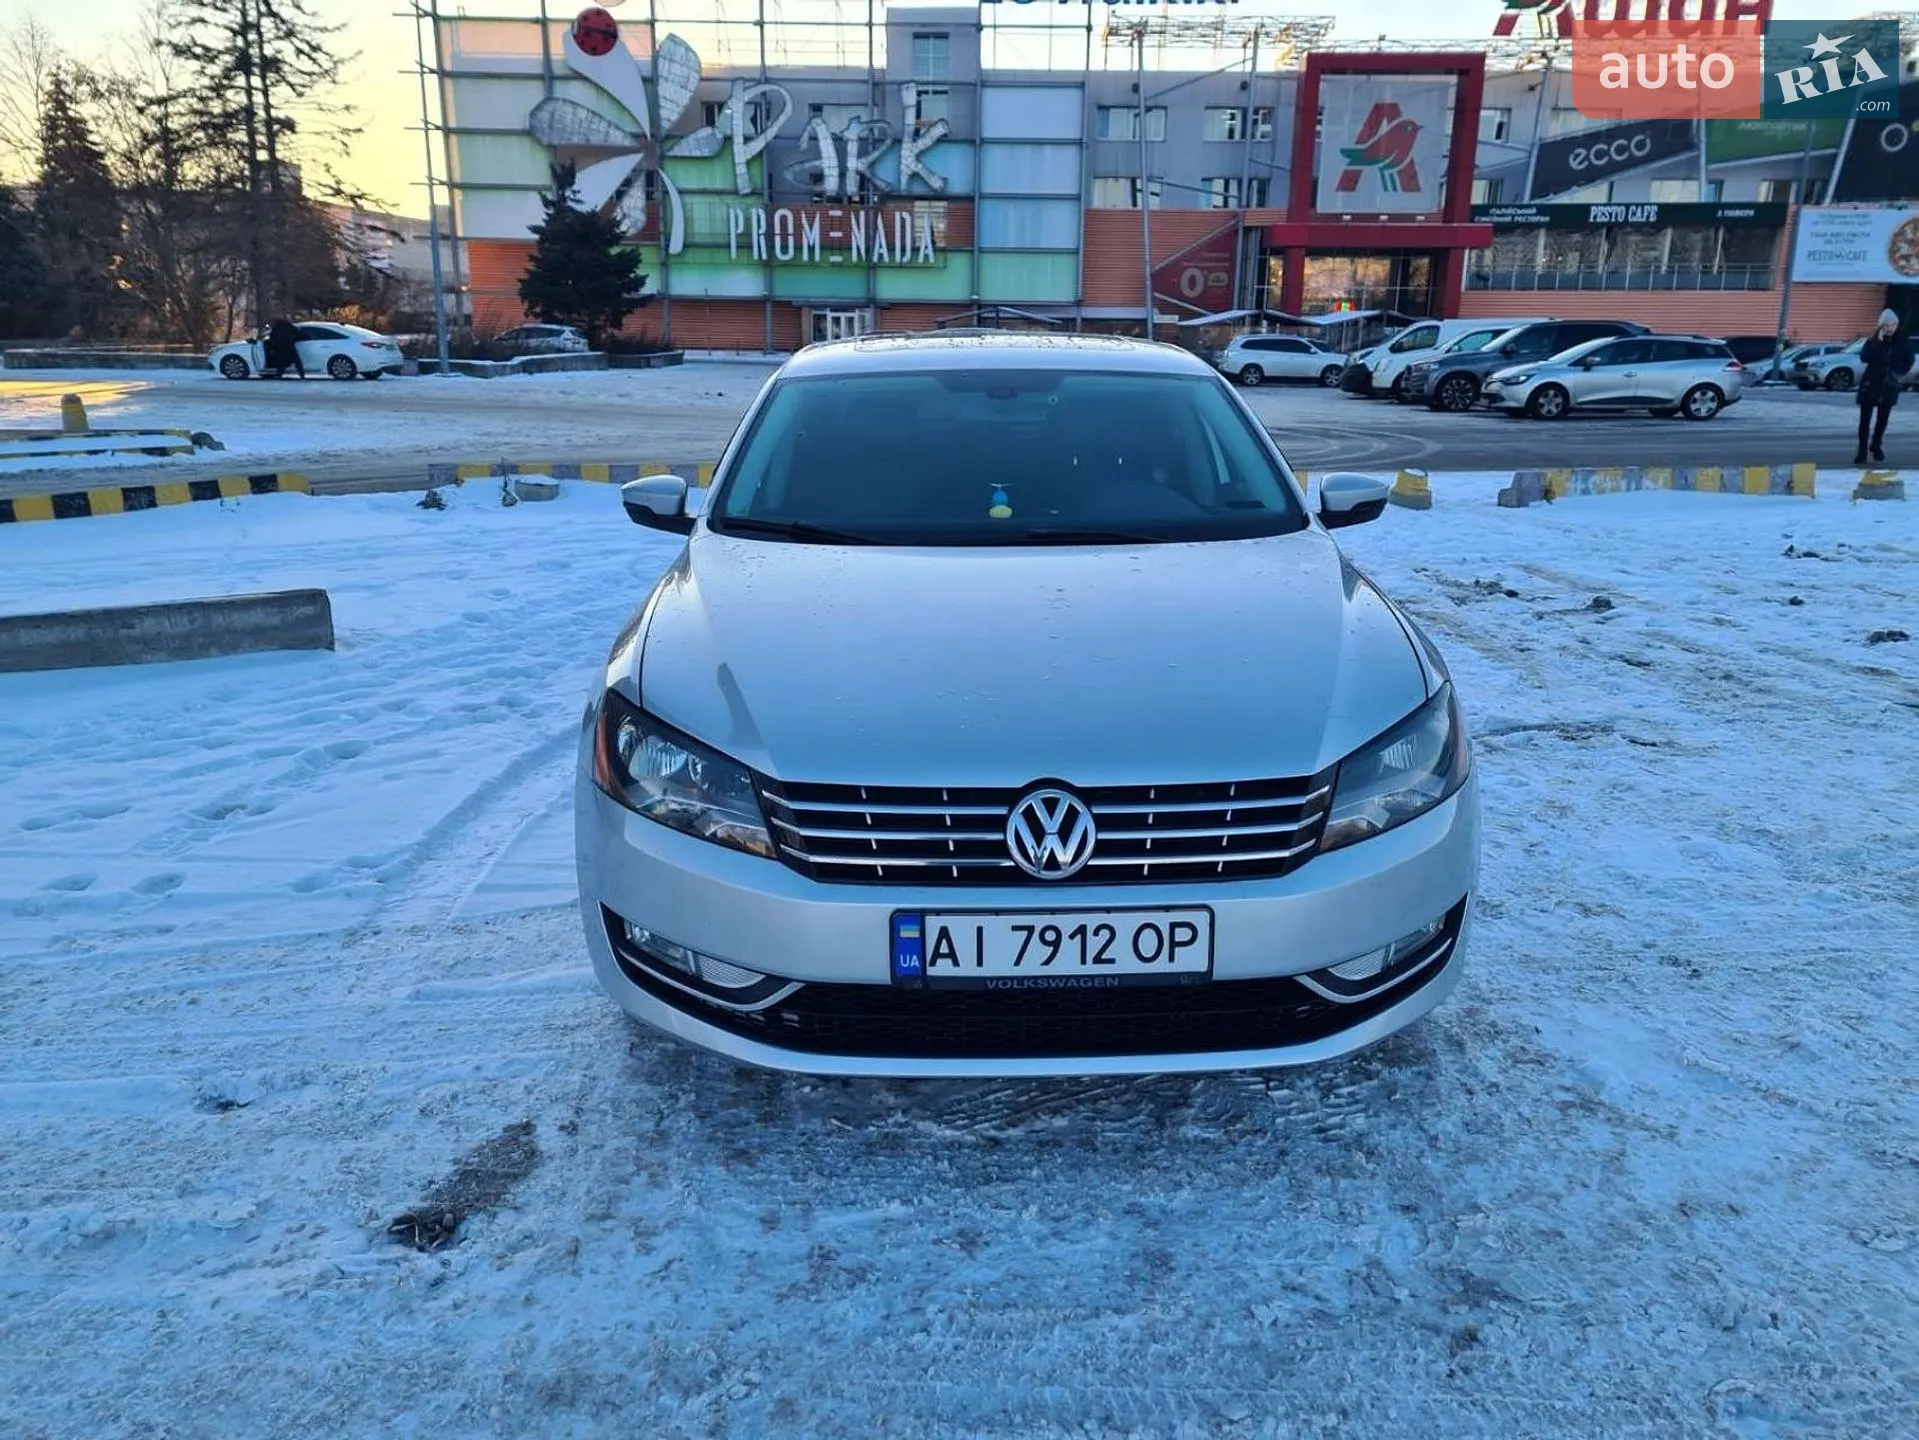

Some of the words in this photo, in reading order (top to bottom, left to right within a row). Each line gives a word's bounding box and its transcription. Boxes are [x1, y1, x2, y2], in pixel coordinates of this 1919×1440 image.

[1569, 134, 1652, 171] ecco
[1589, 205, 1625, 222] PESTO
[1628, 205, 1658, 222] CAFE
[729, 207, 935, 263] PROMENADA
[928, 925, 985, 967] AI
[1011, 923, 1117, 966] 7912
[1132, 921, 1199, 963] OP
[900, 953, 920, 968] UA
[985, 976, 1119, 990] VOLKSWAGEN
